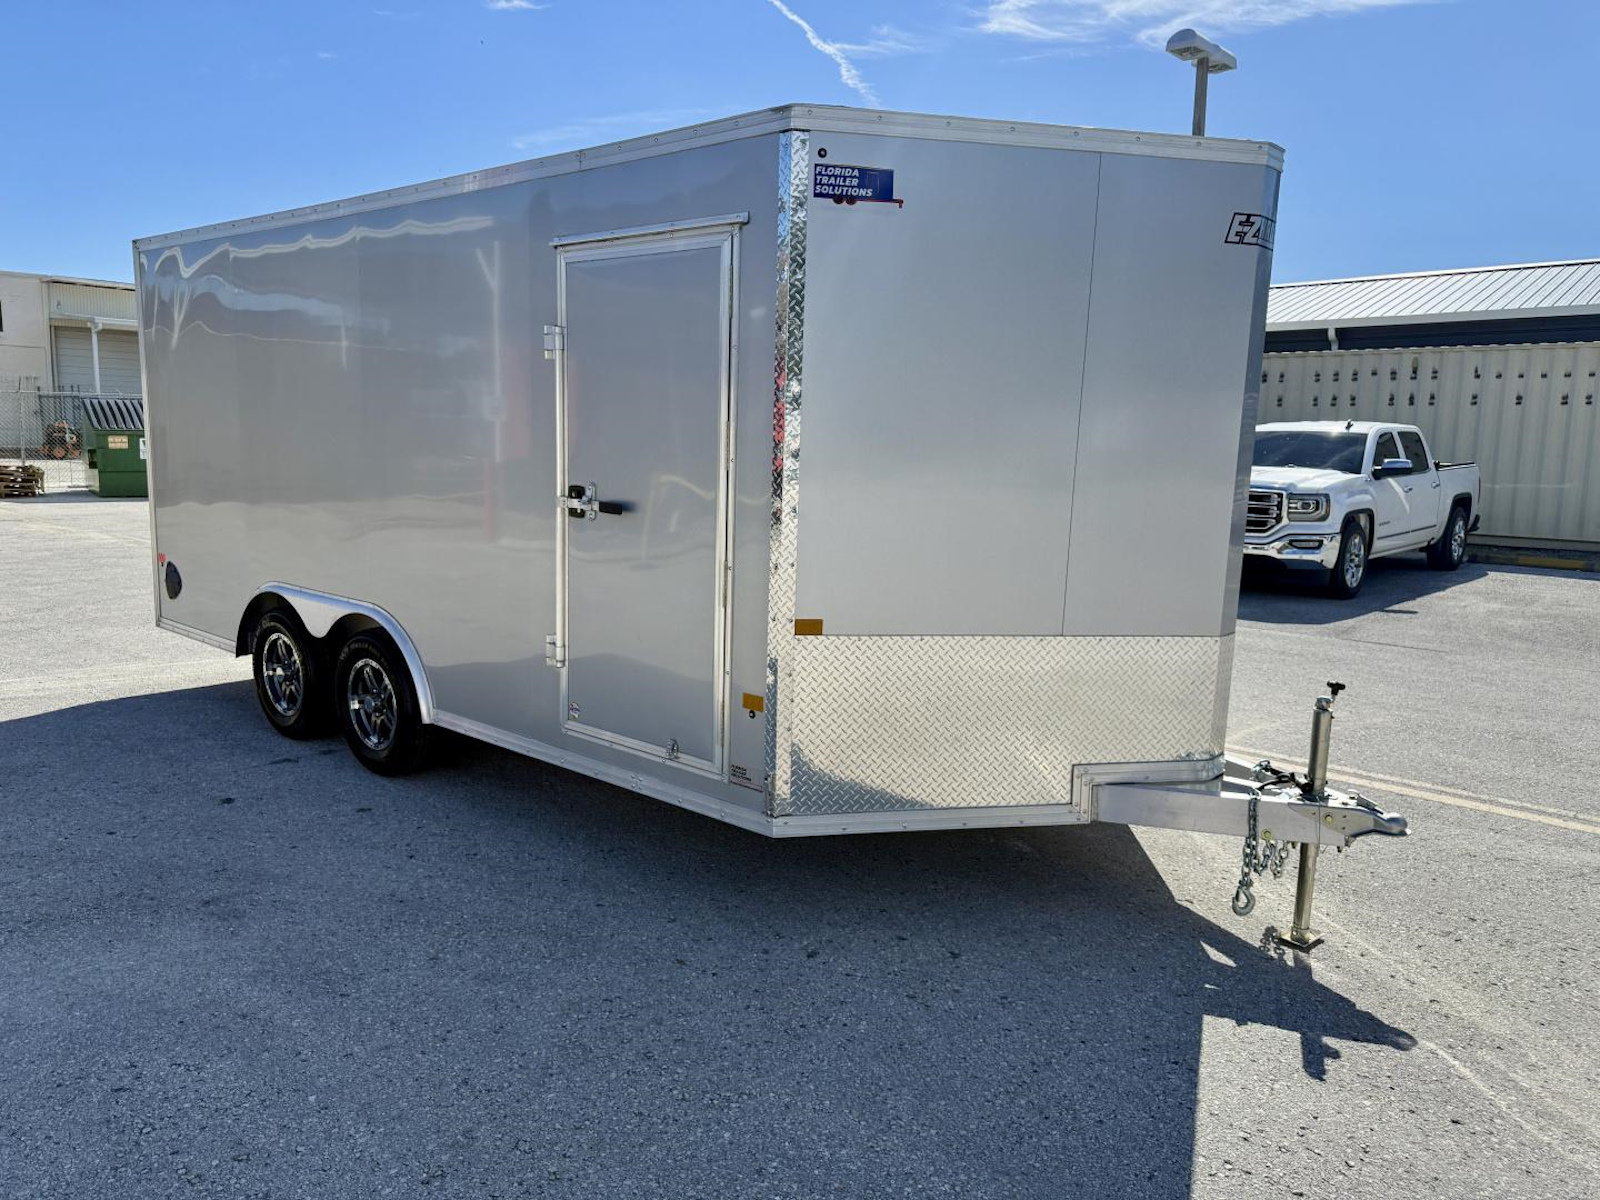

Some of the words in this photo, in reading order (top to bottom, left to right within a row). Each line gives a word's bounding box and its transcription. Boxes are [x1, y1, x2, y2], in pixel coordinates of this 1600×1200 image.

[815, 166, 860, 177] FLORIDA
[815, 176, 859, 187] TRAILER
[814, 185, 873, 197] SOLUTIONS
